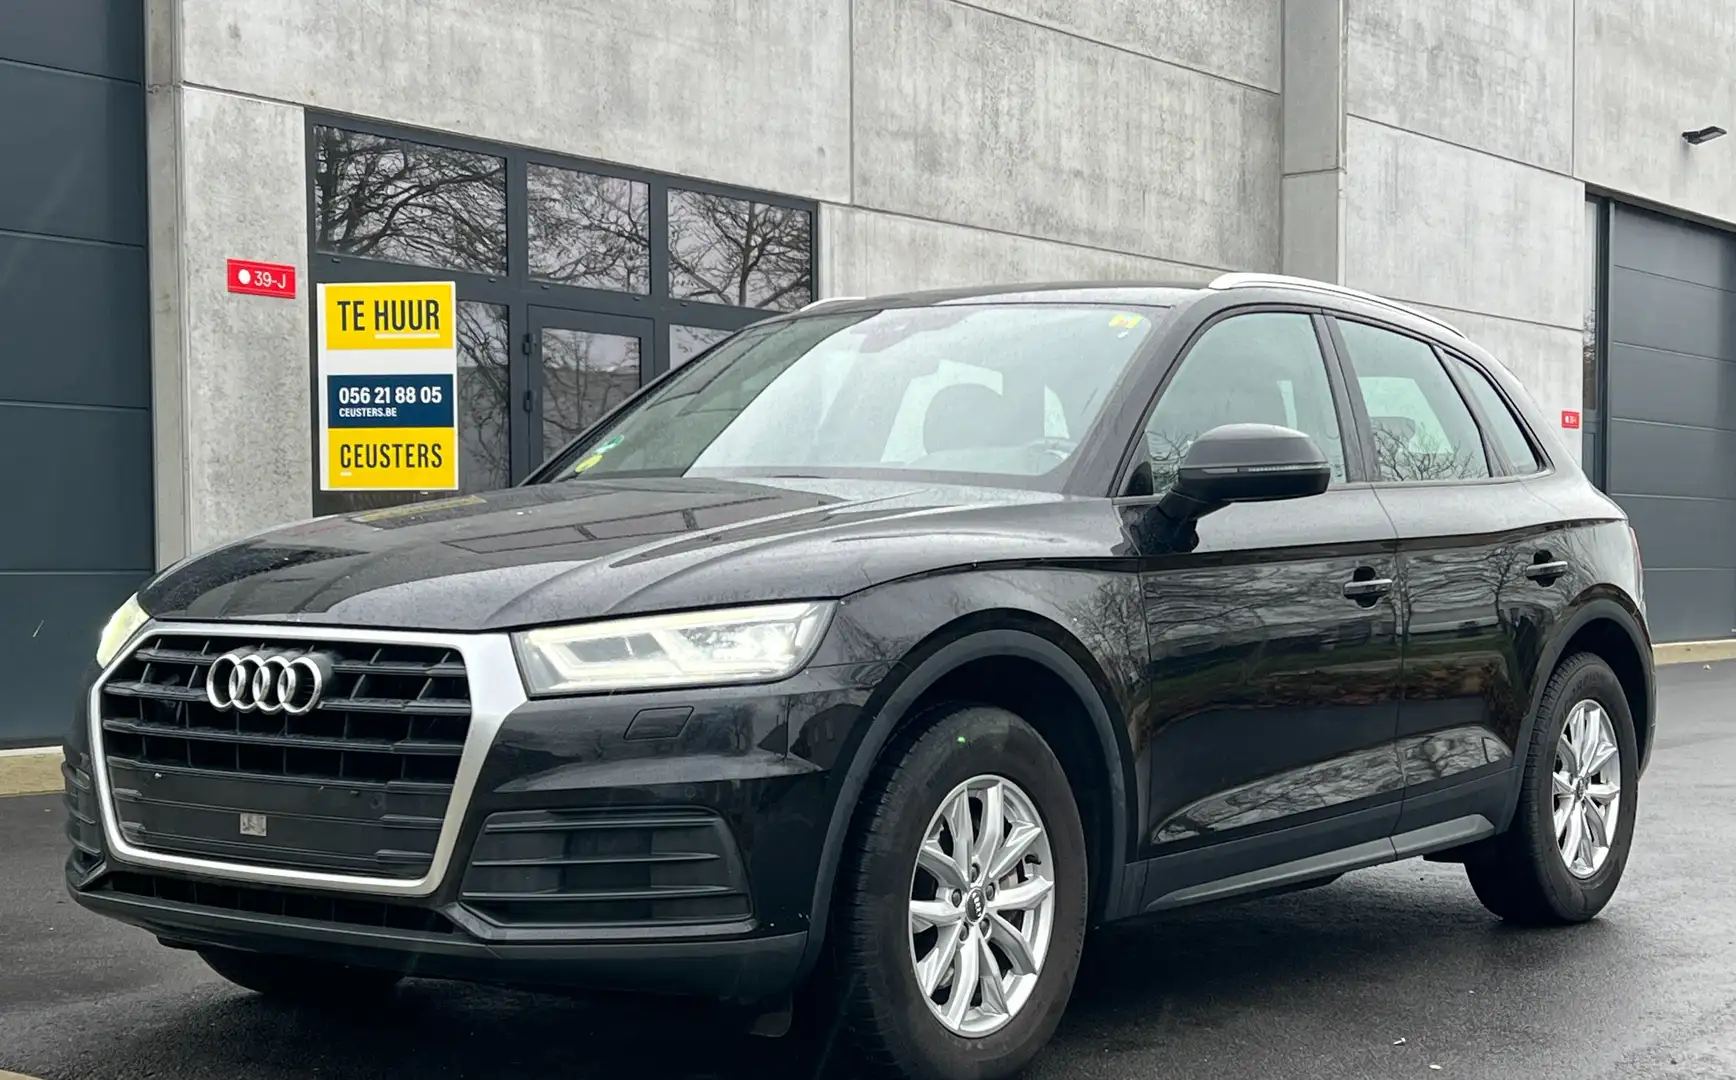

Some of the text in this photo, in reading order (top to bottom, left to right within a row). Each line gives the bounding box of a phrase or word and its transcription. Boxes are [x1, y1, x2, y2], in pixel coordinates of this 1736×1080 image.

[253, 270, 287, 290] 39-J
[337, 299, 441, 332] TE HUUR
[339, 386, 442, 405] 056 21 88 05
[339, 407, 398, 418] CEUSTERS.BE
[340, 443, 443, 469] CEUSTERS
